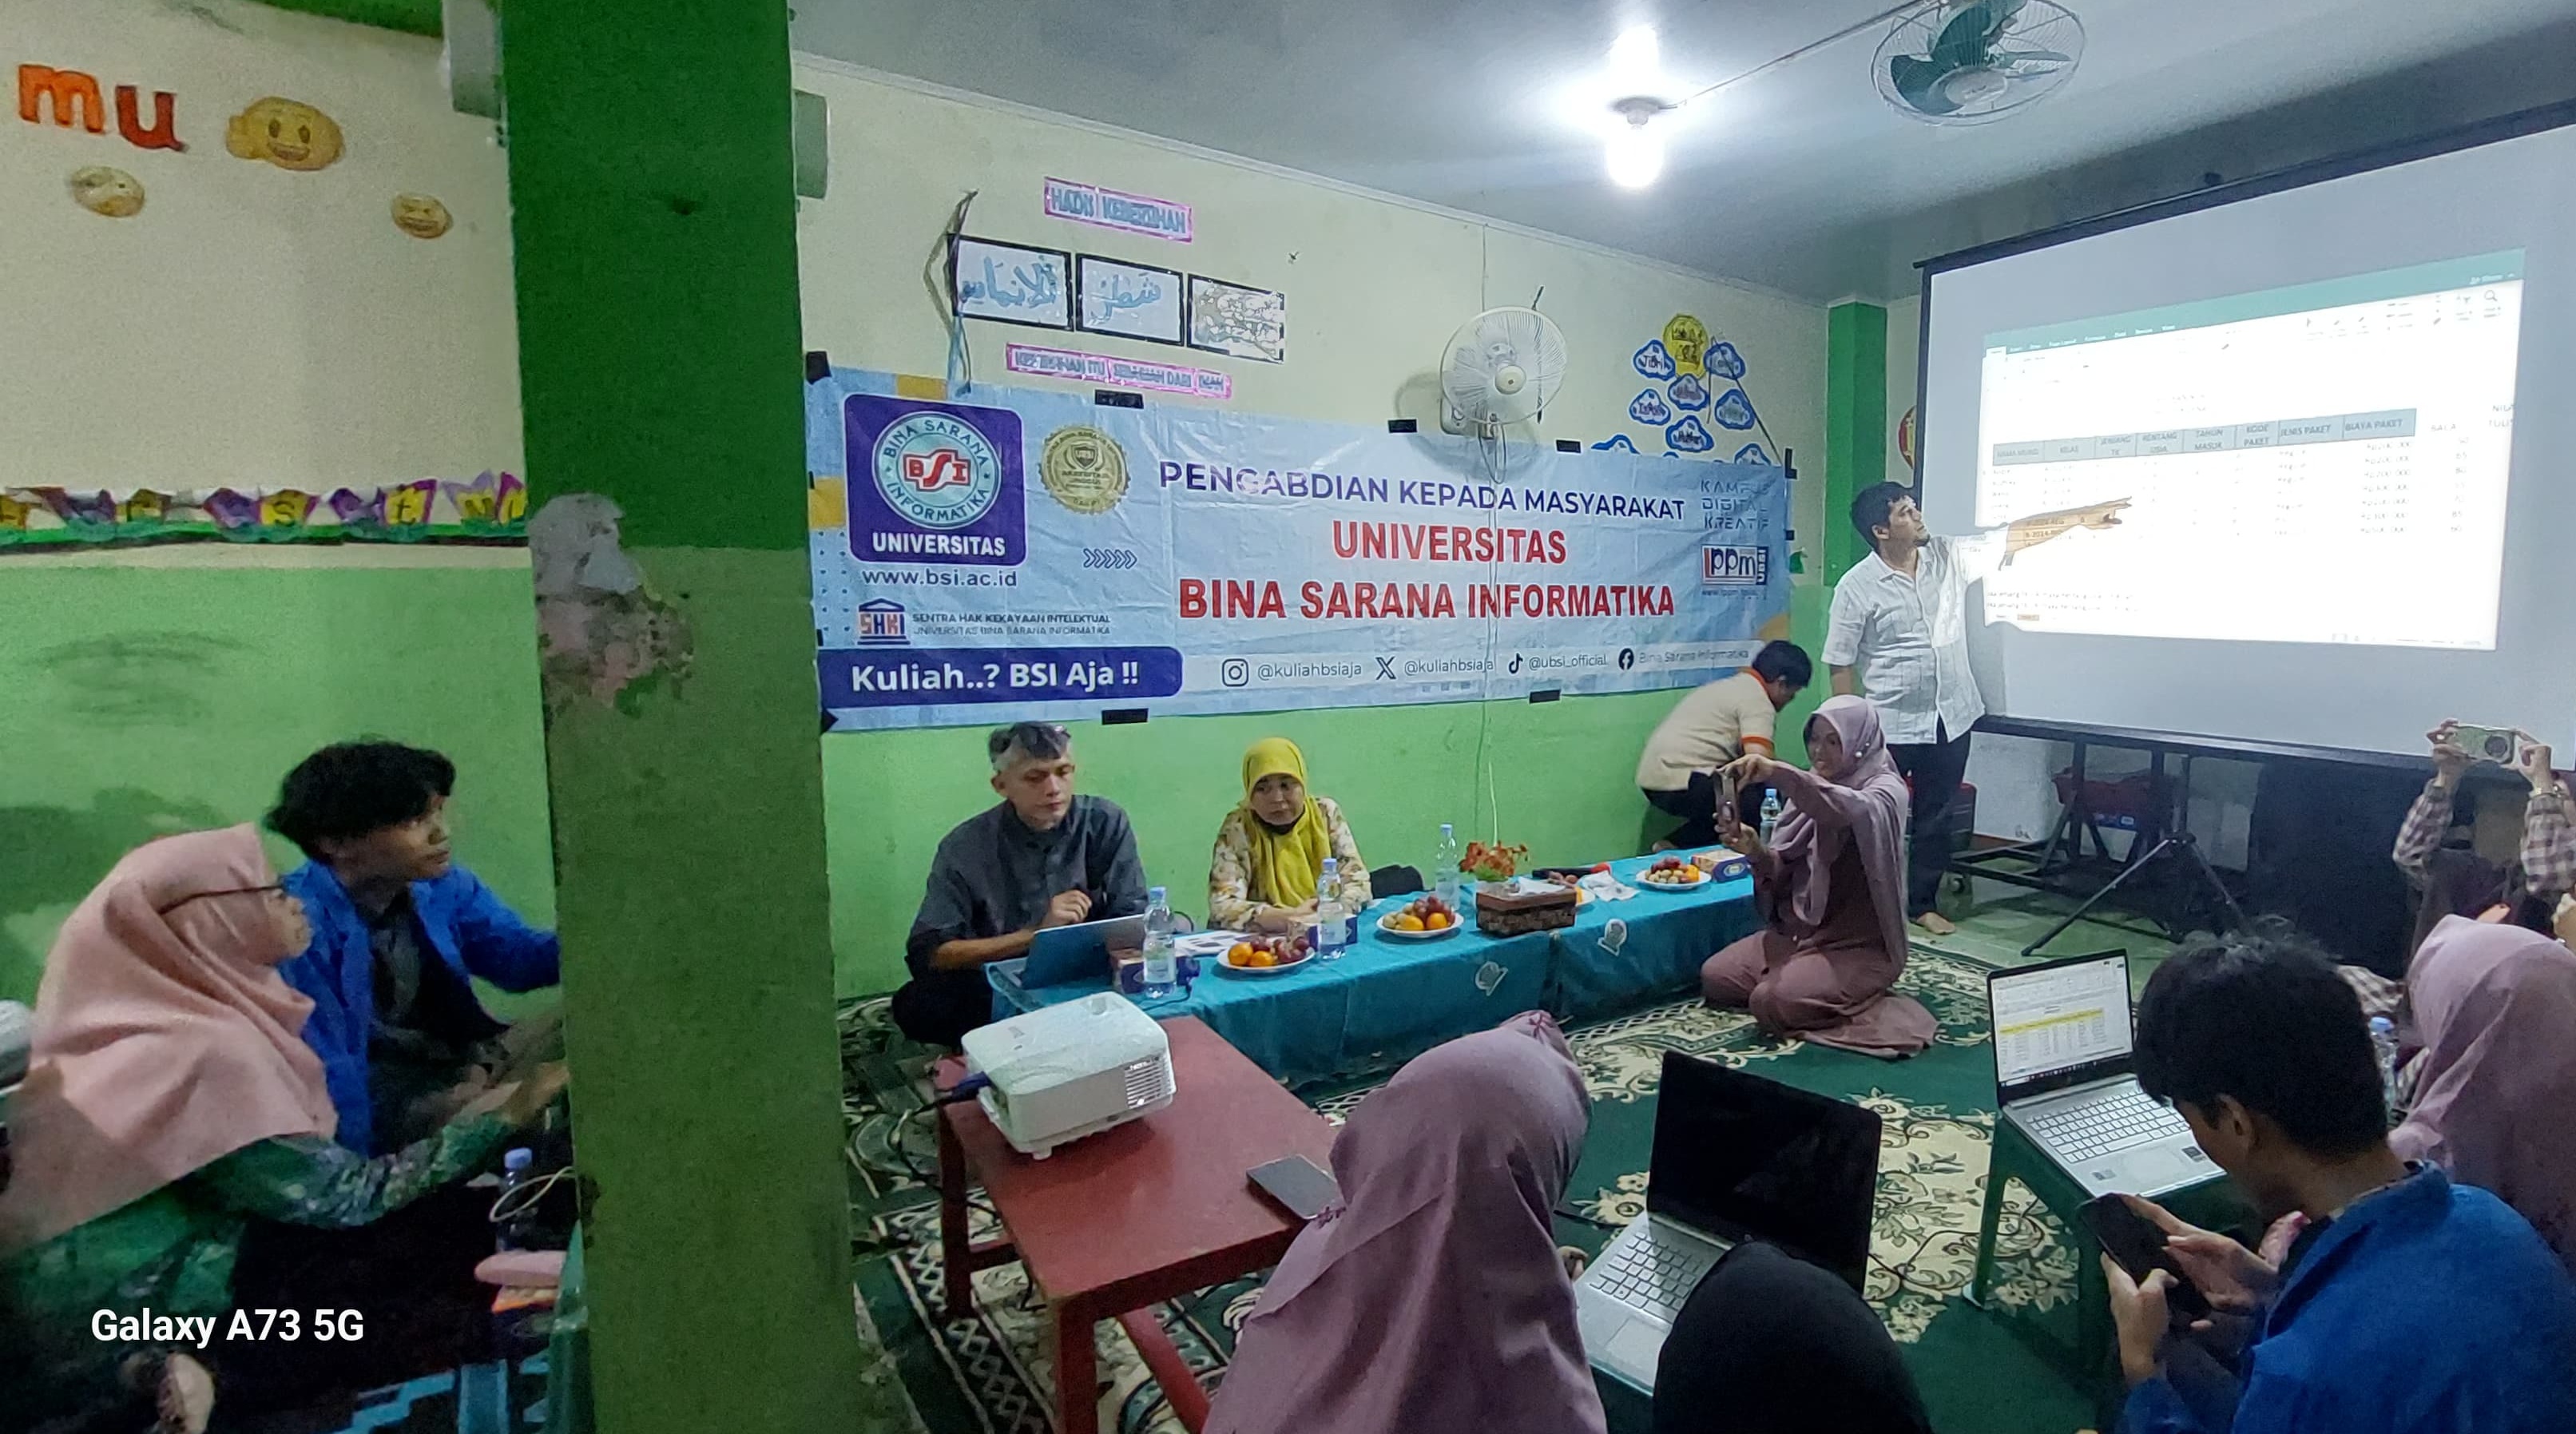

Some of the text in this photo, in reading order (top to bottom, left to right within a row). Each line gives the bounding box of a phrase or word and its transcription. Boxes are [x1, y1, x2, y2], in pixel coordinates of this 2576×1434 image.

[2304, 424, 2331, 435] PAKET
[2375, 419, 2403, 429] PAKET
[883, 419, 990, 467] BINA SARANA
[908, 452, 967, 487] BSI
[887, 481, 990, 521] INFORMATIKA
[1159, 460, 1685, 521] PENGABDIAN KEPADA MASYARAKAT
[872, 531, 1006, 557] UNIVERSITAS
[1333, 519, 1567, 564] UNIVERSITAS
[863, 568, 1018, 587] www.bsi.ac.id
[1179, 578, 1675, 618] BINA SARANA INFORMATIKA
[912, 614, 1111, 624] SENTRA HAK KEKAYAAN INTELEKTUAL
[1257, 663, 1363, 681] @kuliahbsiaja
[1404, 659, 1494, 677] @kuliahbsiaja
[1529, 654, 1607, 671] @ubsi_official
[1010, 664, 1058, 685] BSI
[1066, 663, 1115, 692] Aja
[1121, 662, 1139, 684] !!
